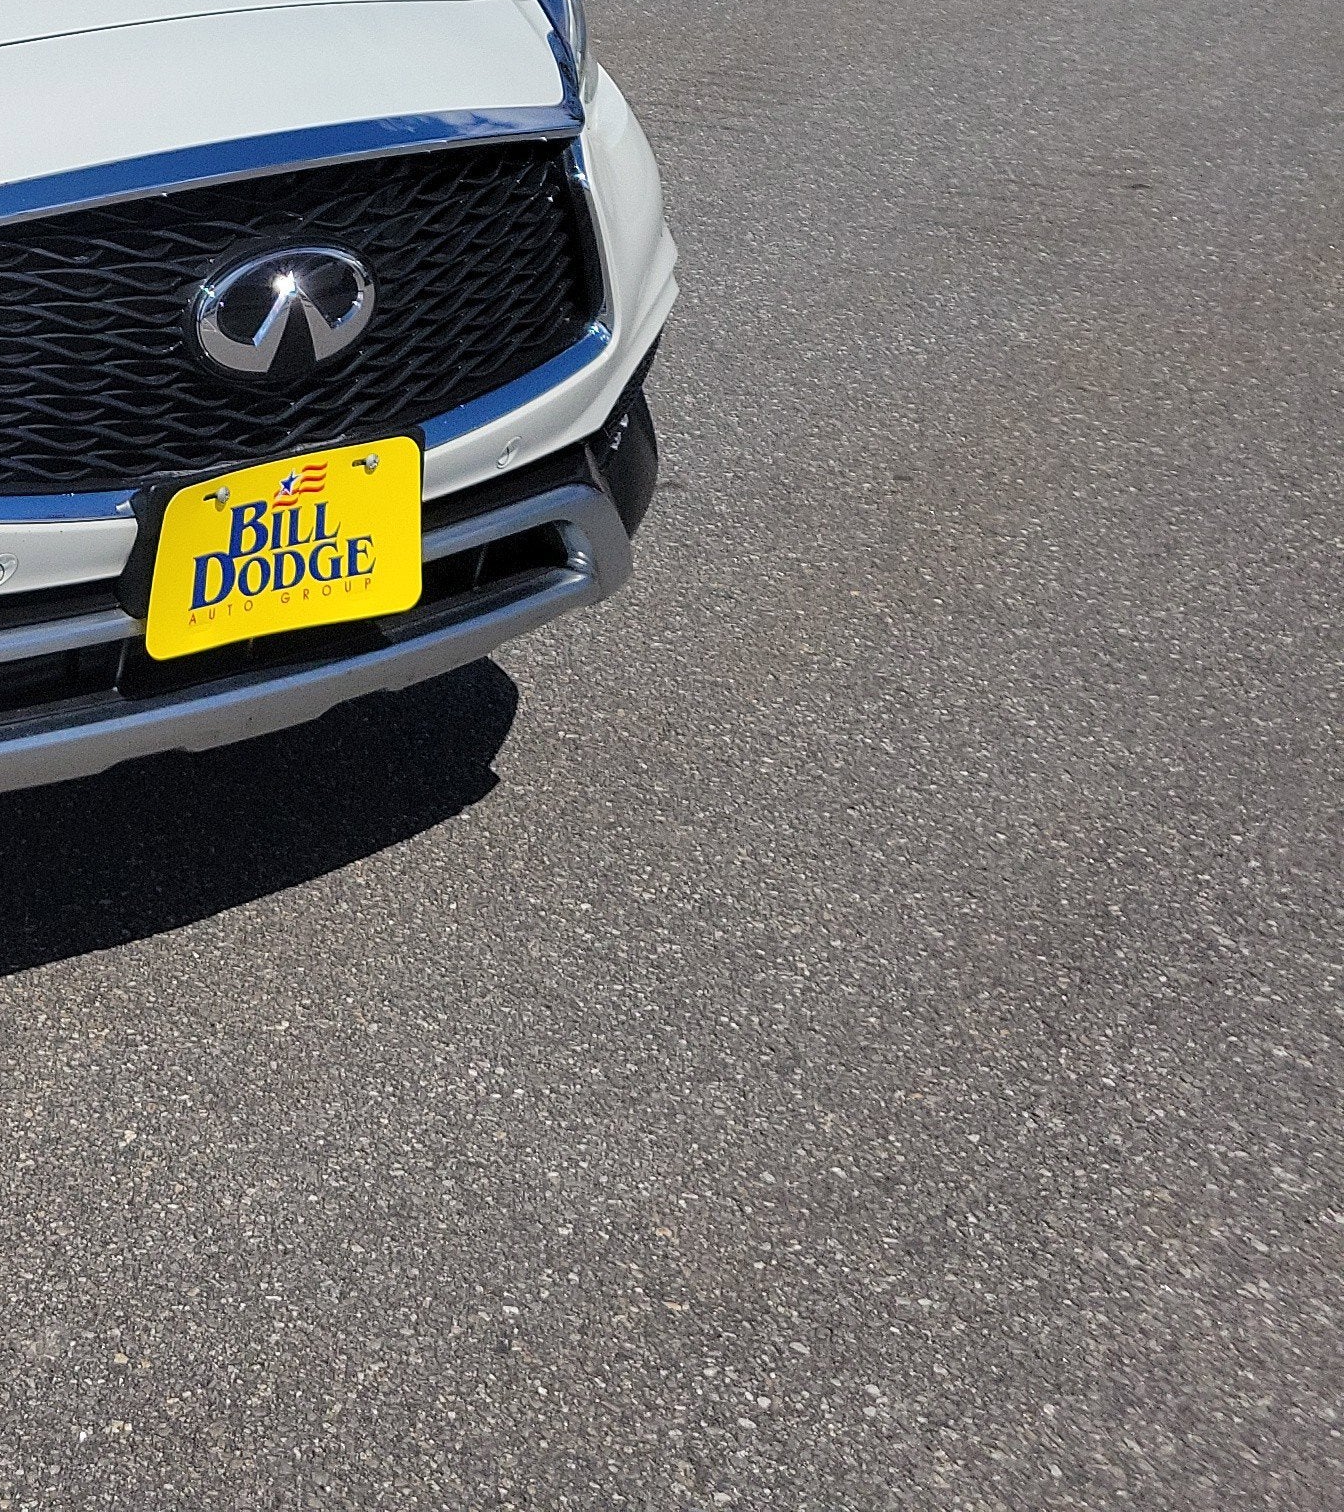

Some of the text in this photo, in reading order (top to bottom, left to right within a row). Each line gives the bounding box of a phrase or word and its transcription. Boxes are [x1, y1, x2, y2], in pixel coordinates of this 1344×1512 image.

[229, 499, 341, 558] BILL
[188, 534, 377, 612] DODGE
[188, 577, 373, 626] AUTO GROUP
